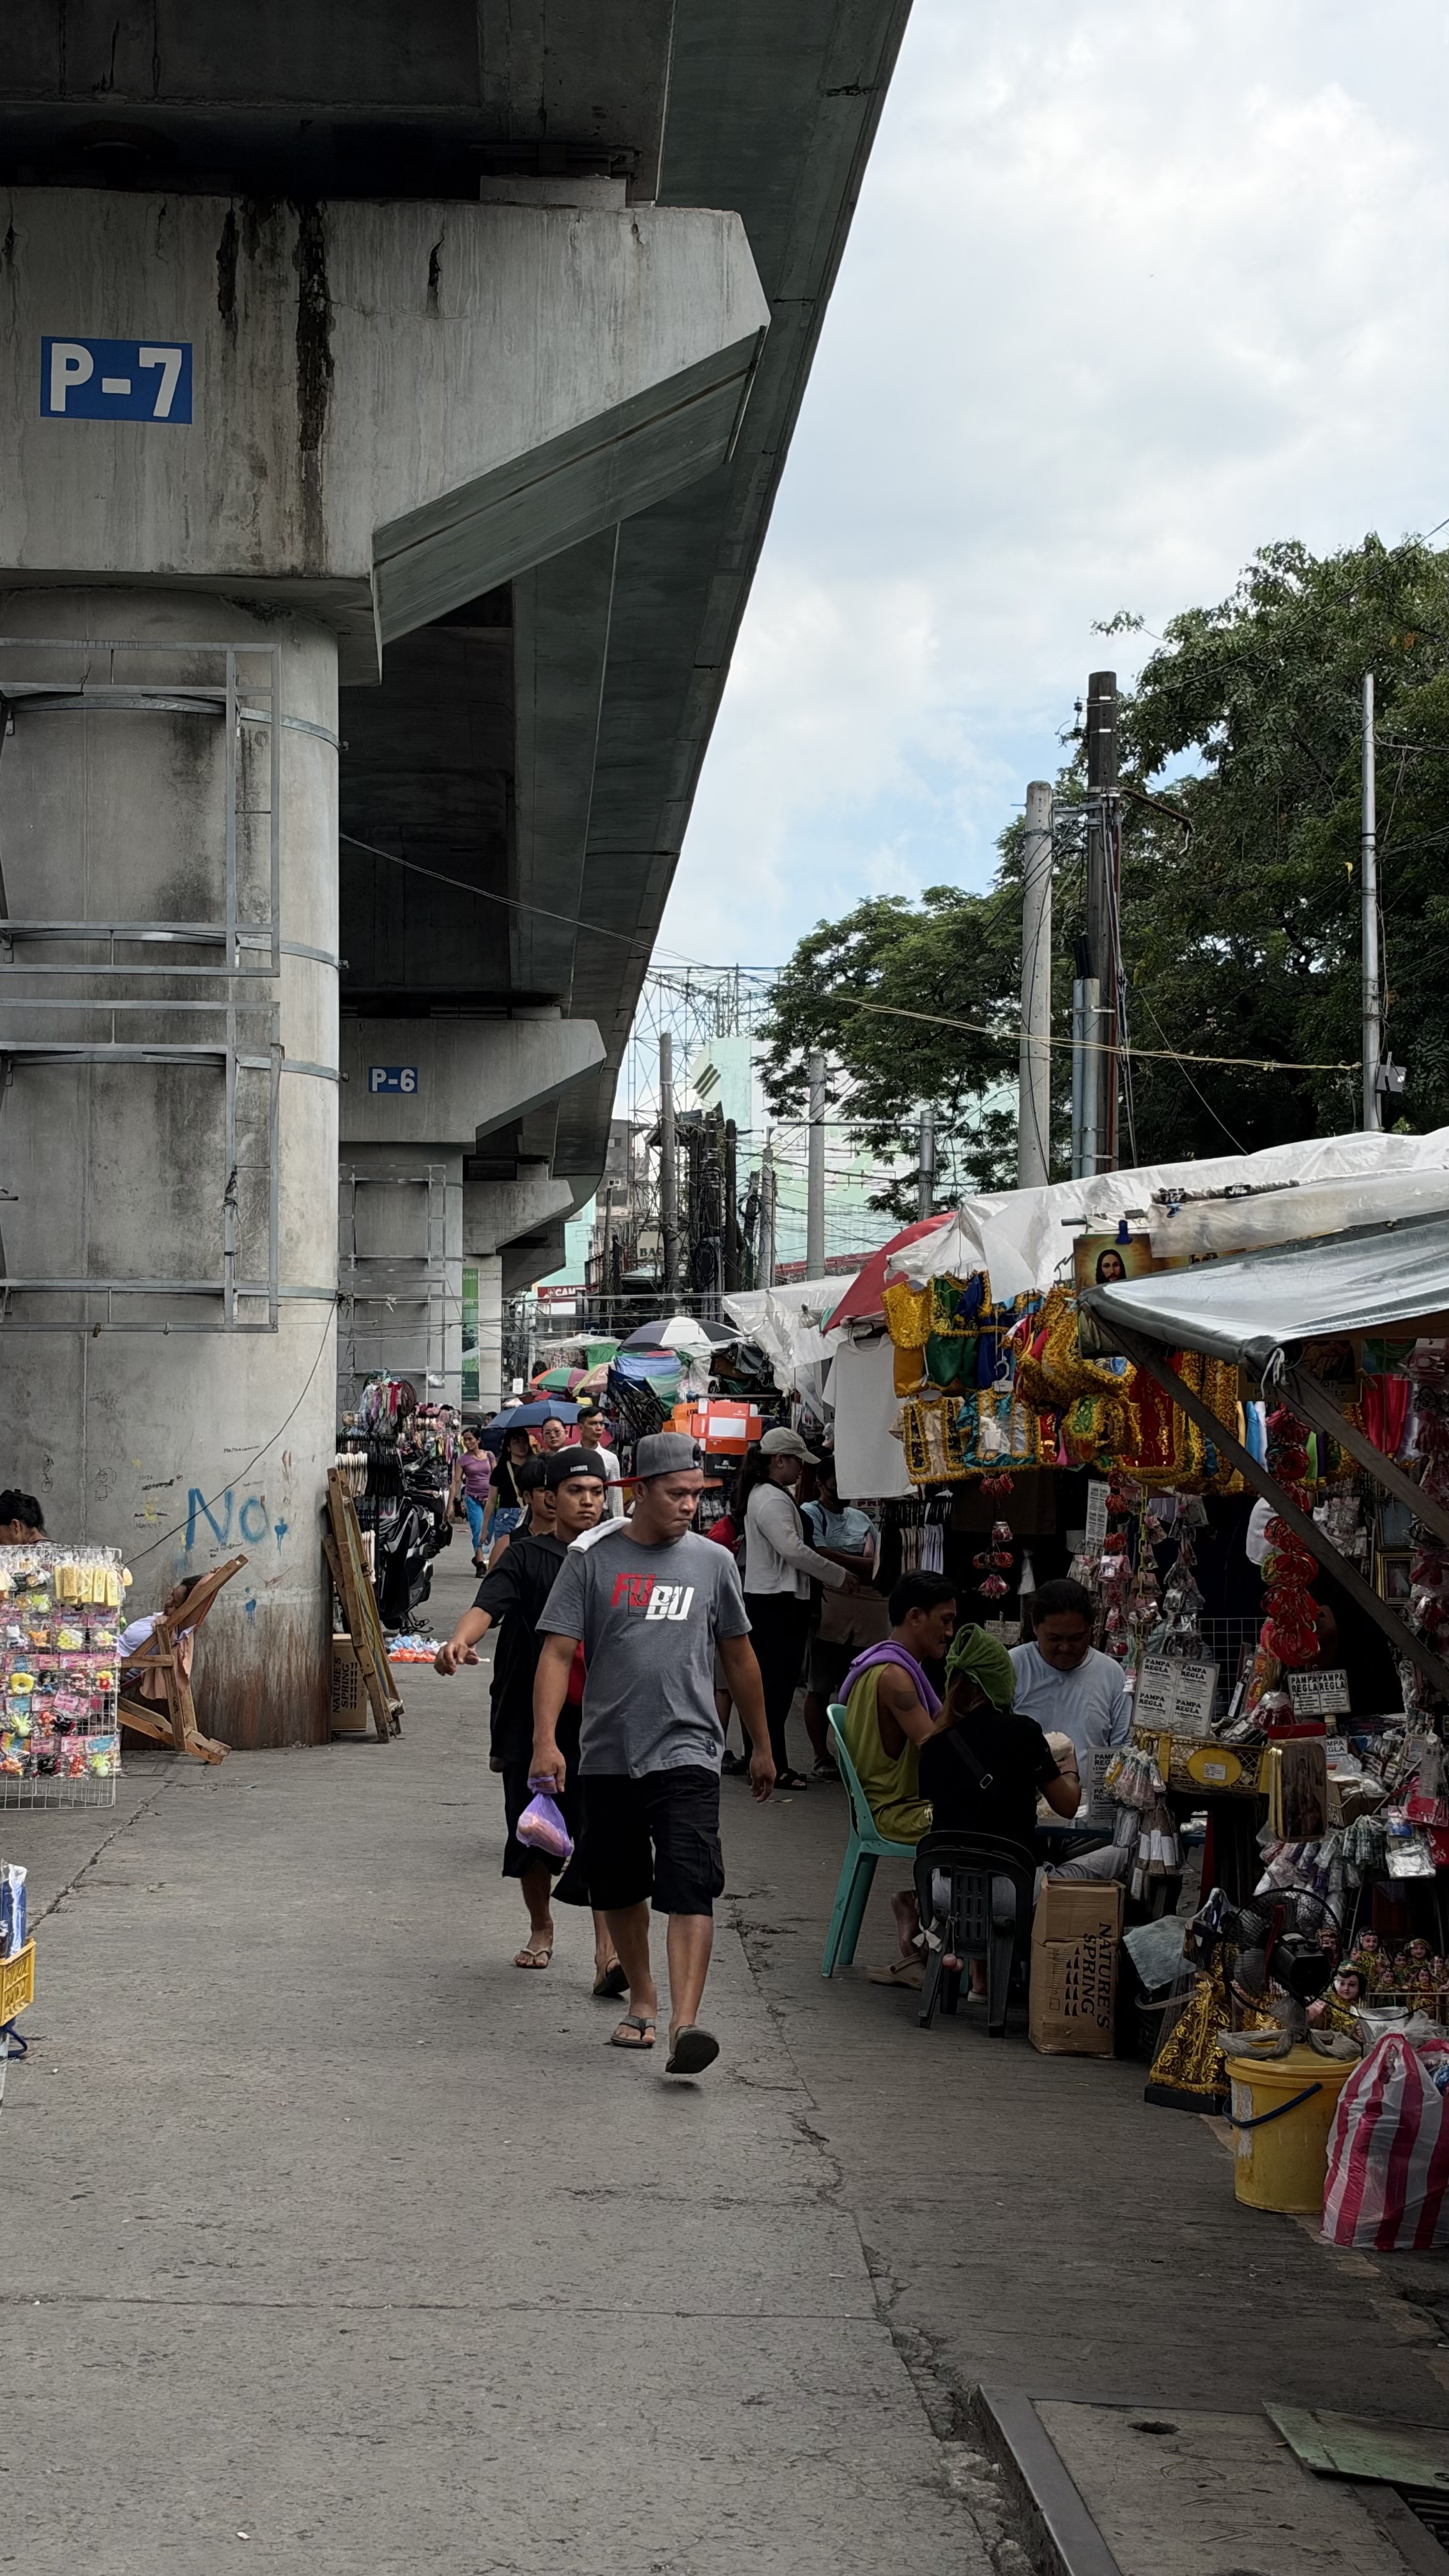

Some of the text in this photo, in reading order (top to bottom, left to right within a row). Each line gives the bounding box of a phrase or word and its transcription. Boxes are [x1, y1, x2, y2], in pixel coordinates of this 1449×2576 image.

[50, 342, 182, 418] P-7
[372, 1068, 415, 1092] P-6
[610, 1574, 694, 1620] FUBU
[1146, 1659, 1170, 1667] PAMPA
[1183, 1665, 1207, 1673] PAMPA
[332, 1657, 341, 1713] NATURE'S
[341, 1663, 349, 1708] SPRING
[1140, 1693, 1165, 1701] PAMPA
[1320, 1682, 1346, 1690] REGLA
[1139, 1699, 1163, 1707] REGLA
[1081, 1933, 1096, 2014] SPRING
[1096, 1922, 1112, 2029] NATURE'S
